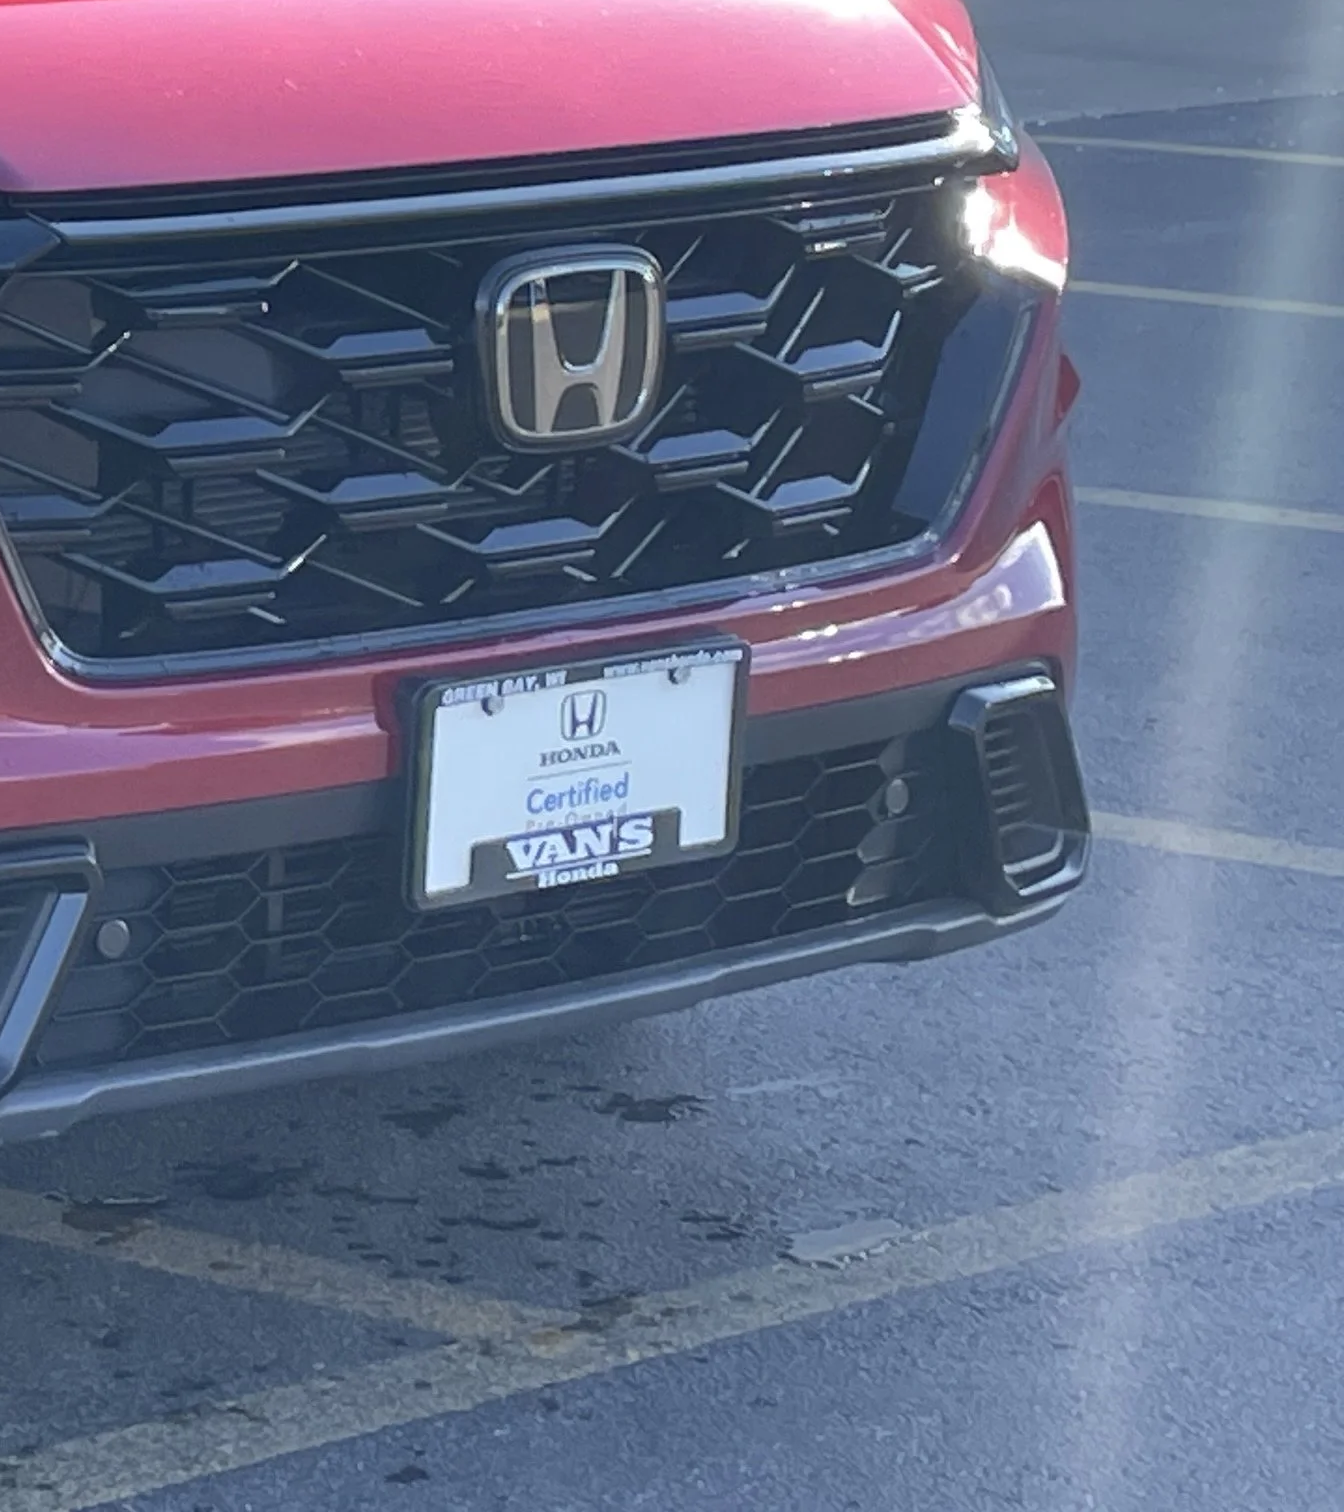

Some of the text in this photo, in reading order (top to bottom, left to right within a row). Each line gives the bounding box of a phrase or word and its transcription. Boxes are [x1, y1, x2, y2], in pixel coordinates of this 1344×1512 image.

[539, 740, 621, 767] HONDA
[527, 771, 629, 814] Certified
[538, 862, 619, 888] Honda
